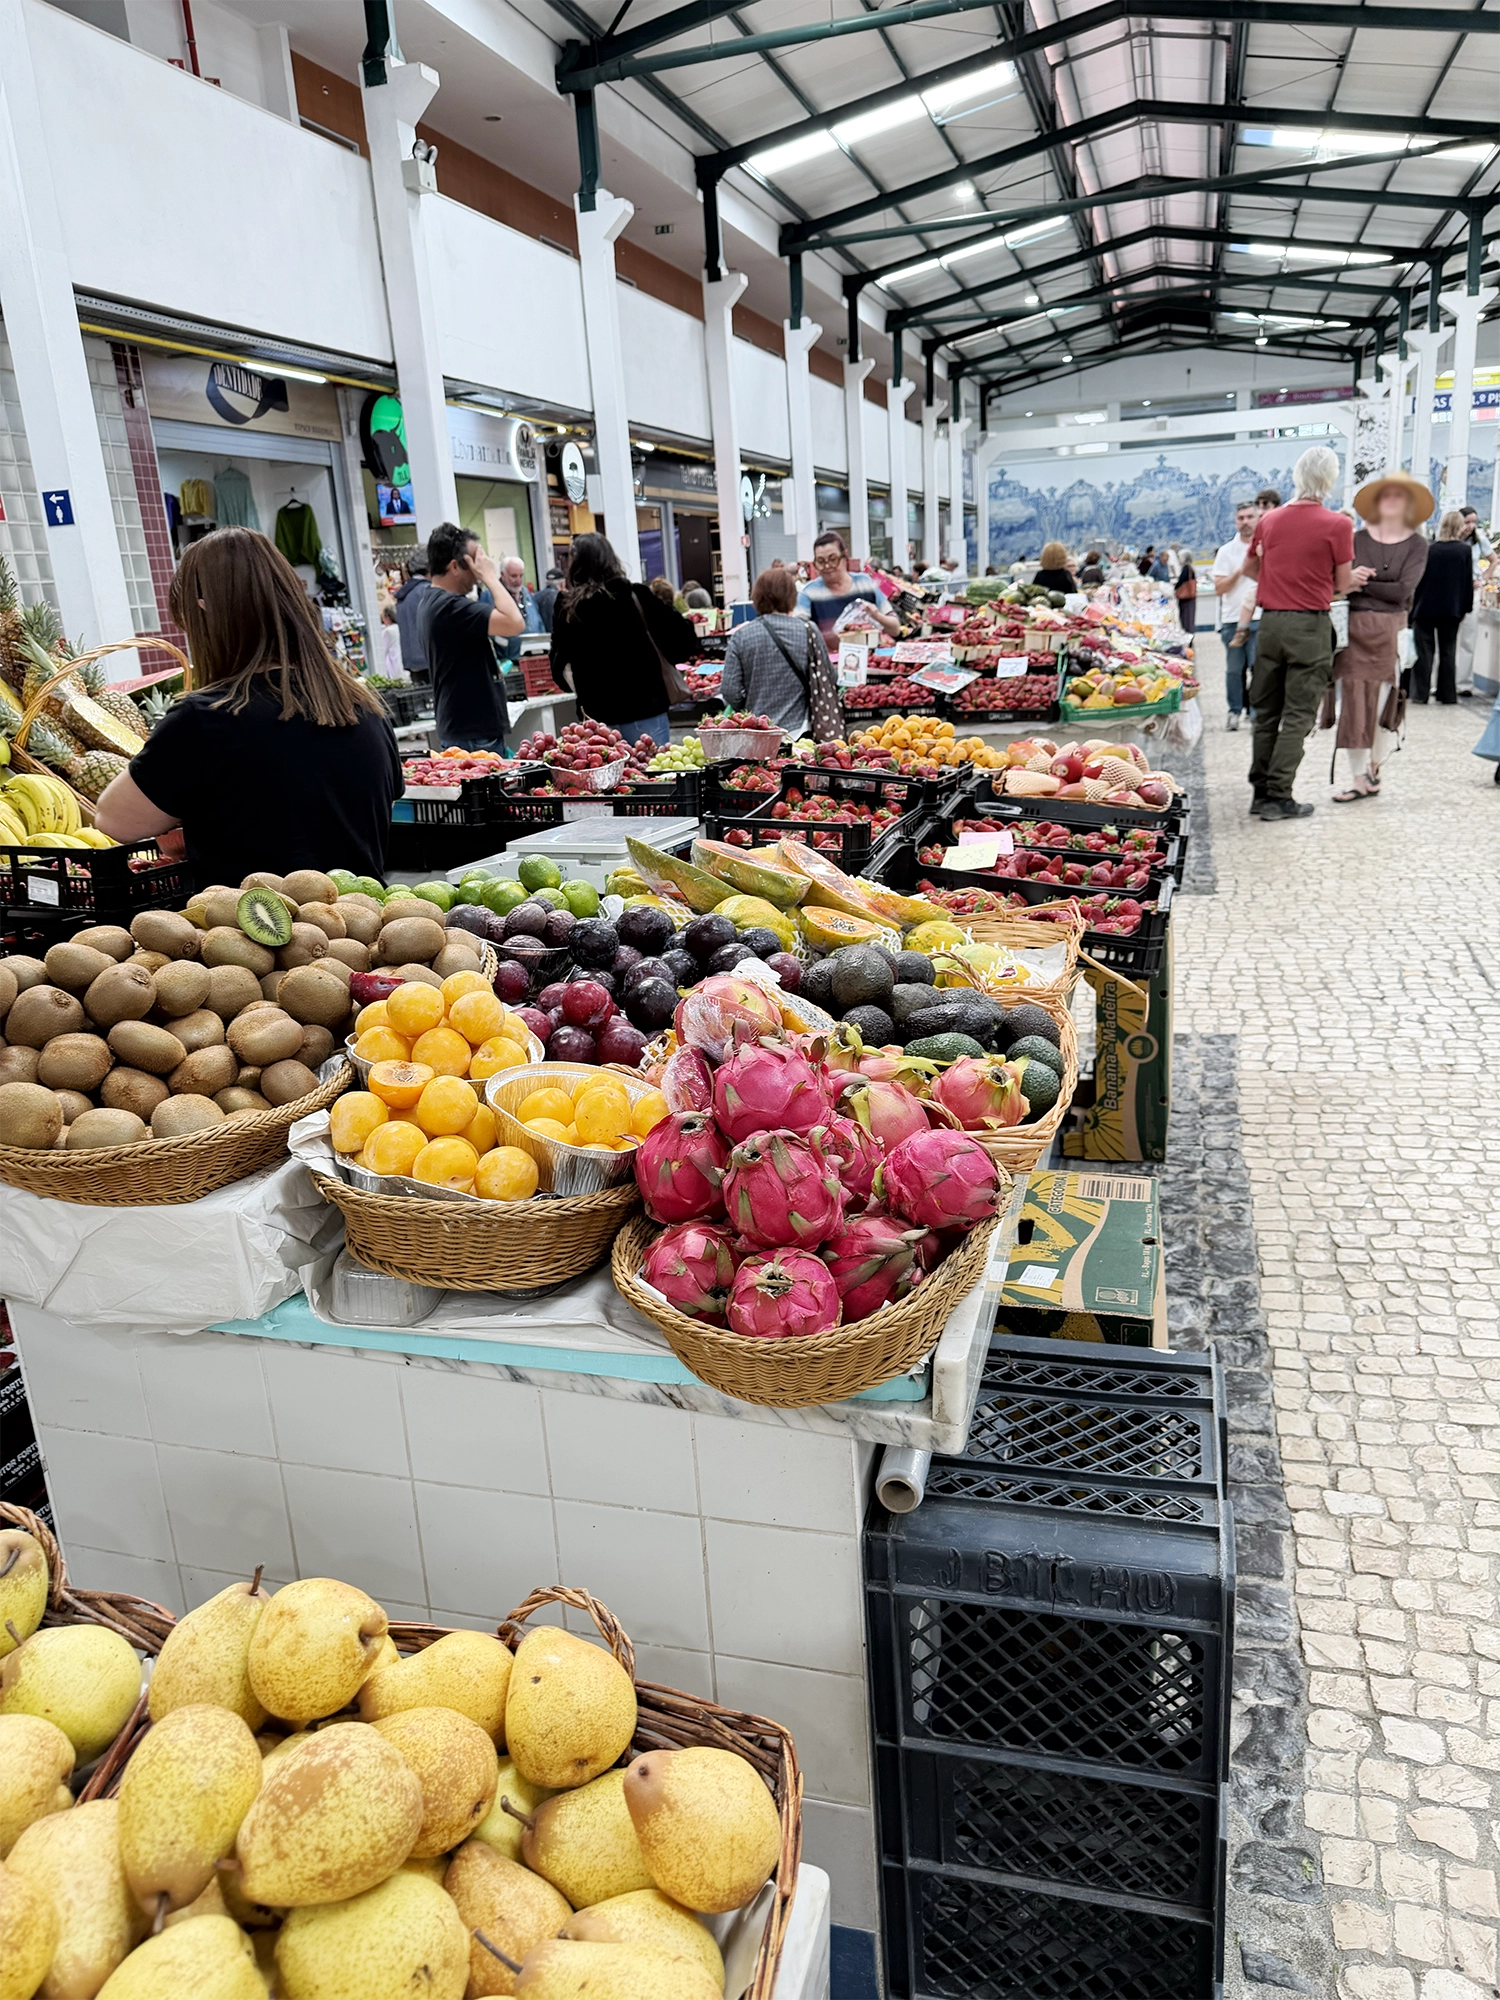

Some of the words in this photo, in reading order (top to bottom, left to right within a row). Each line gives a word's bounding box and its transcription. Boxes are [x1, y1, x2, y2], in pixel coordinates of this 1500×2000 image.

[213, 363, 263, 402] IDENTIDADE
[1103, 1055, 1118, 1110] Banana
[1048, 1175, 1068, 1214] CATEGORIA
